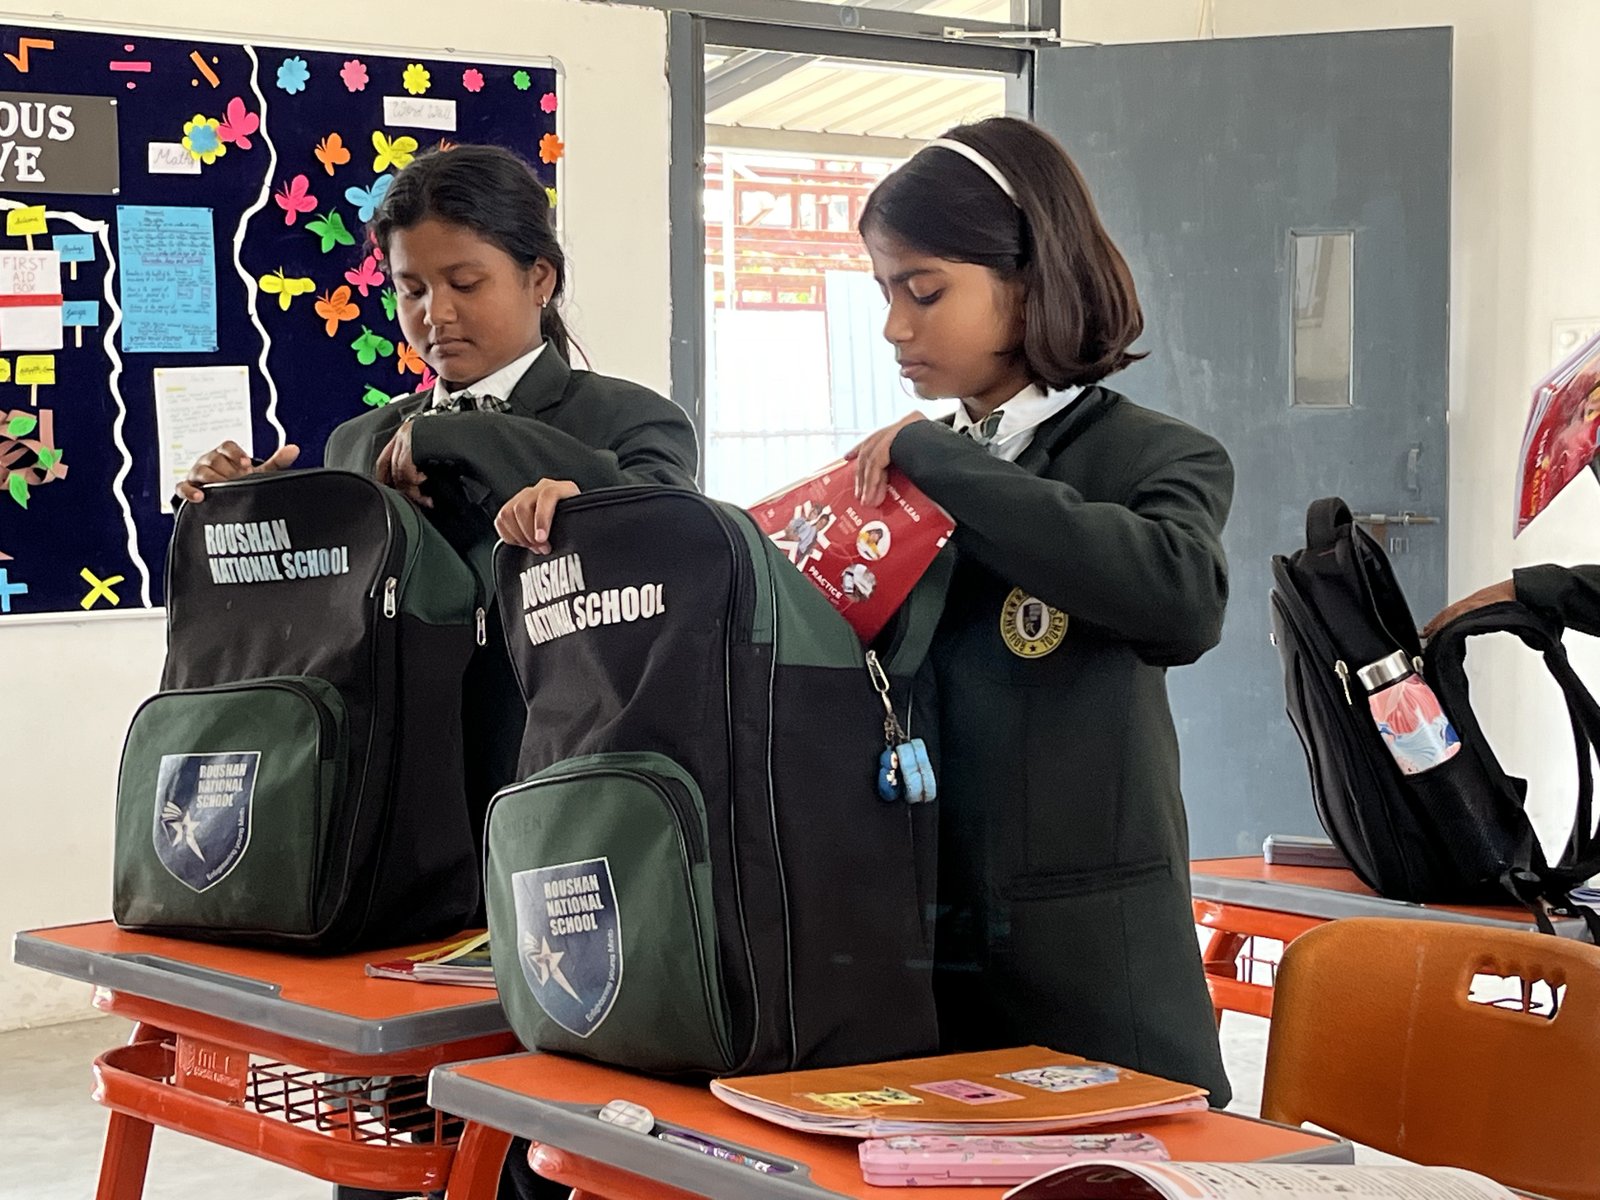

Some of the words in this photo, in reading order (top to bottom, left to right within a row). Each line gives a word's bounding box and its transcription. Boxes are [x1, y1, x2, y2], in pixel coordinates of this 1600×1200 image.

[3, 257, 47, 271] FIRST
[13, 271, 35, 283] AID
[13, 283, 35, 295] BOX
[845, 506, 863, 527] READ
[204, 519, 292, 555] ROUSHAN
[209, 555, 284, 584] NATIONAL
[281, 546, 349, 579] SCHOOL
[808, 565, 843, 600] PRACTICE
[573, 583, 665, 630] SCHOOL
[199, 763, 248, 779] ROUSHAN
[198, 778, 244, 794] NATIONAL
[196, 793, 234, 809] SCHOOL
[544, 874, 600, 899] ROUSHAN
[546, 892, 605, 917] NATIONAL
[550, 912, 599, 937] SCHOOL
